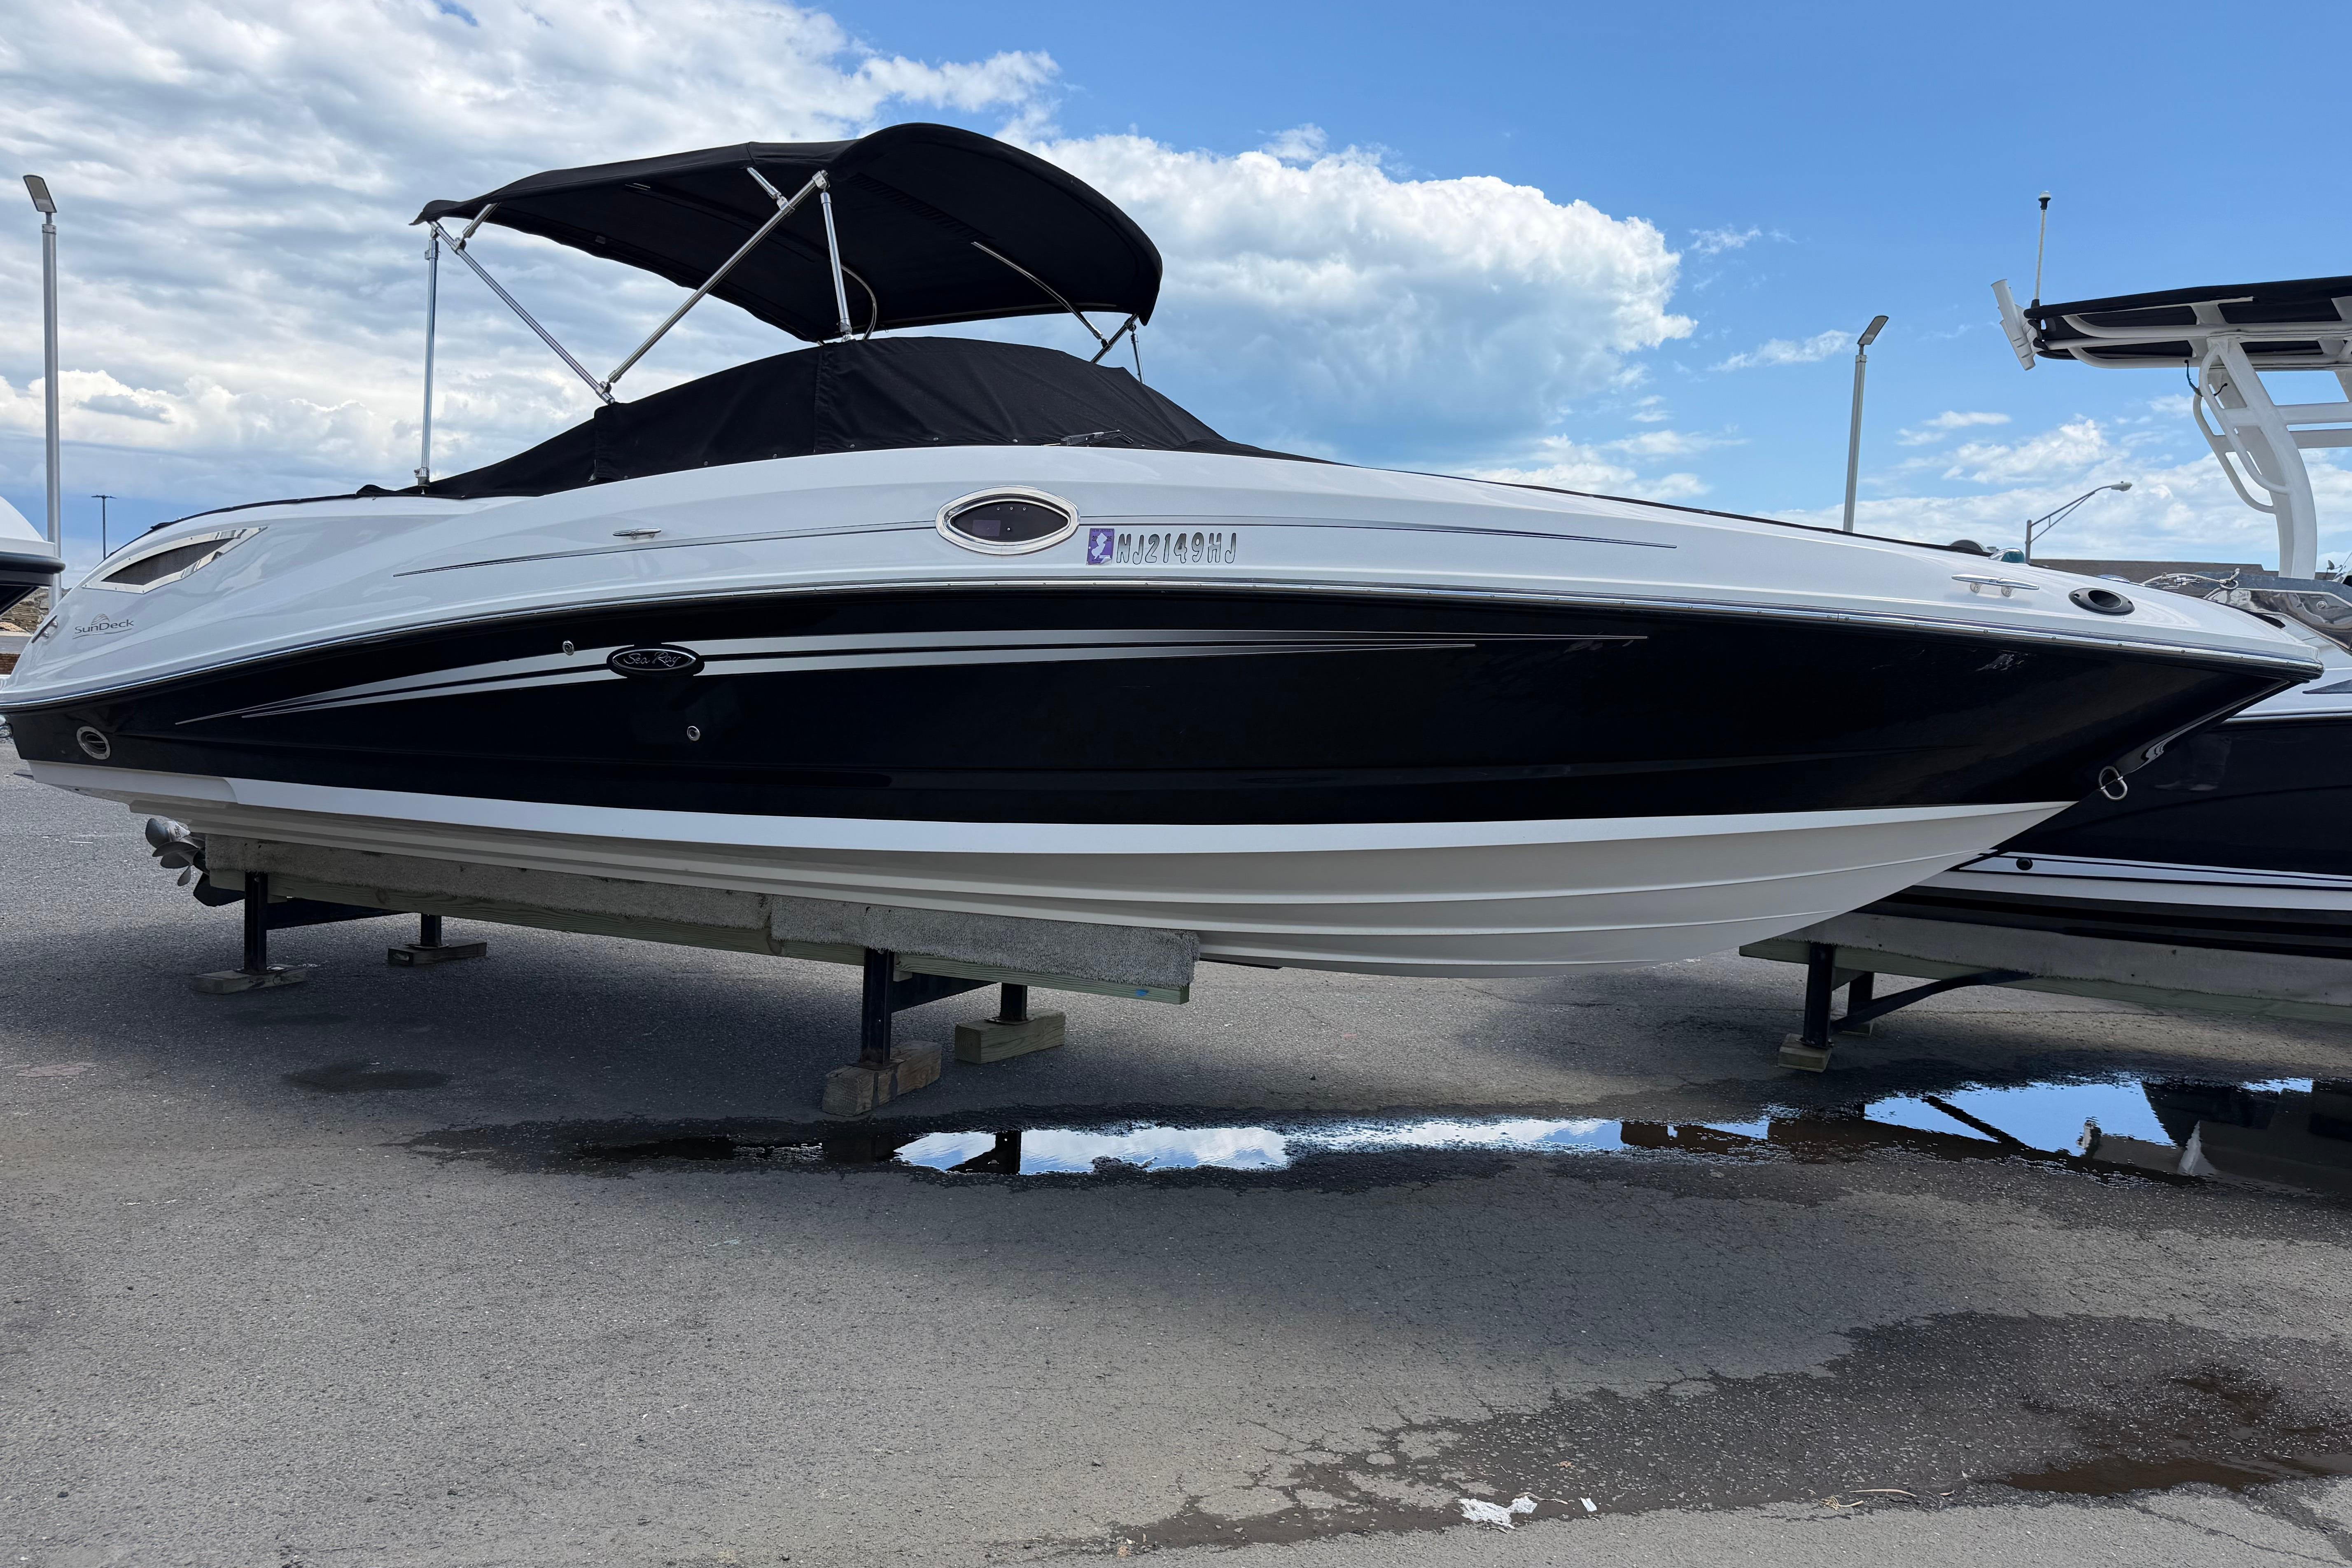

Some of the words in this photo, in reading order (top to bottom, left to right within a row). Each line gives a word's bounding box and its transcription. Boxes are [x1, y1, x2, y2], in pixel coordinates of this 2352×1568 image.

[74, 619, 134, 634] SunDeck
[623, 653, 650, 664] Sea
[652, 651, 681, 667] Ray
